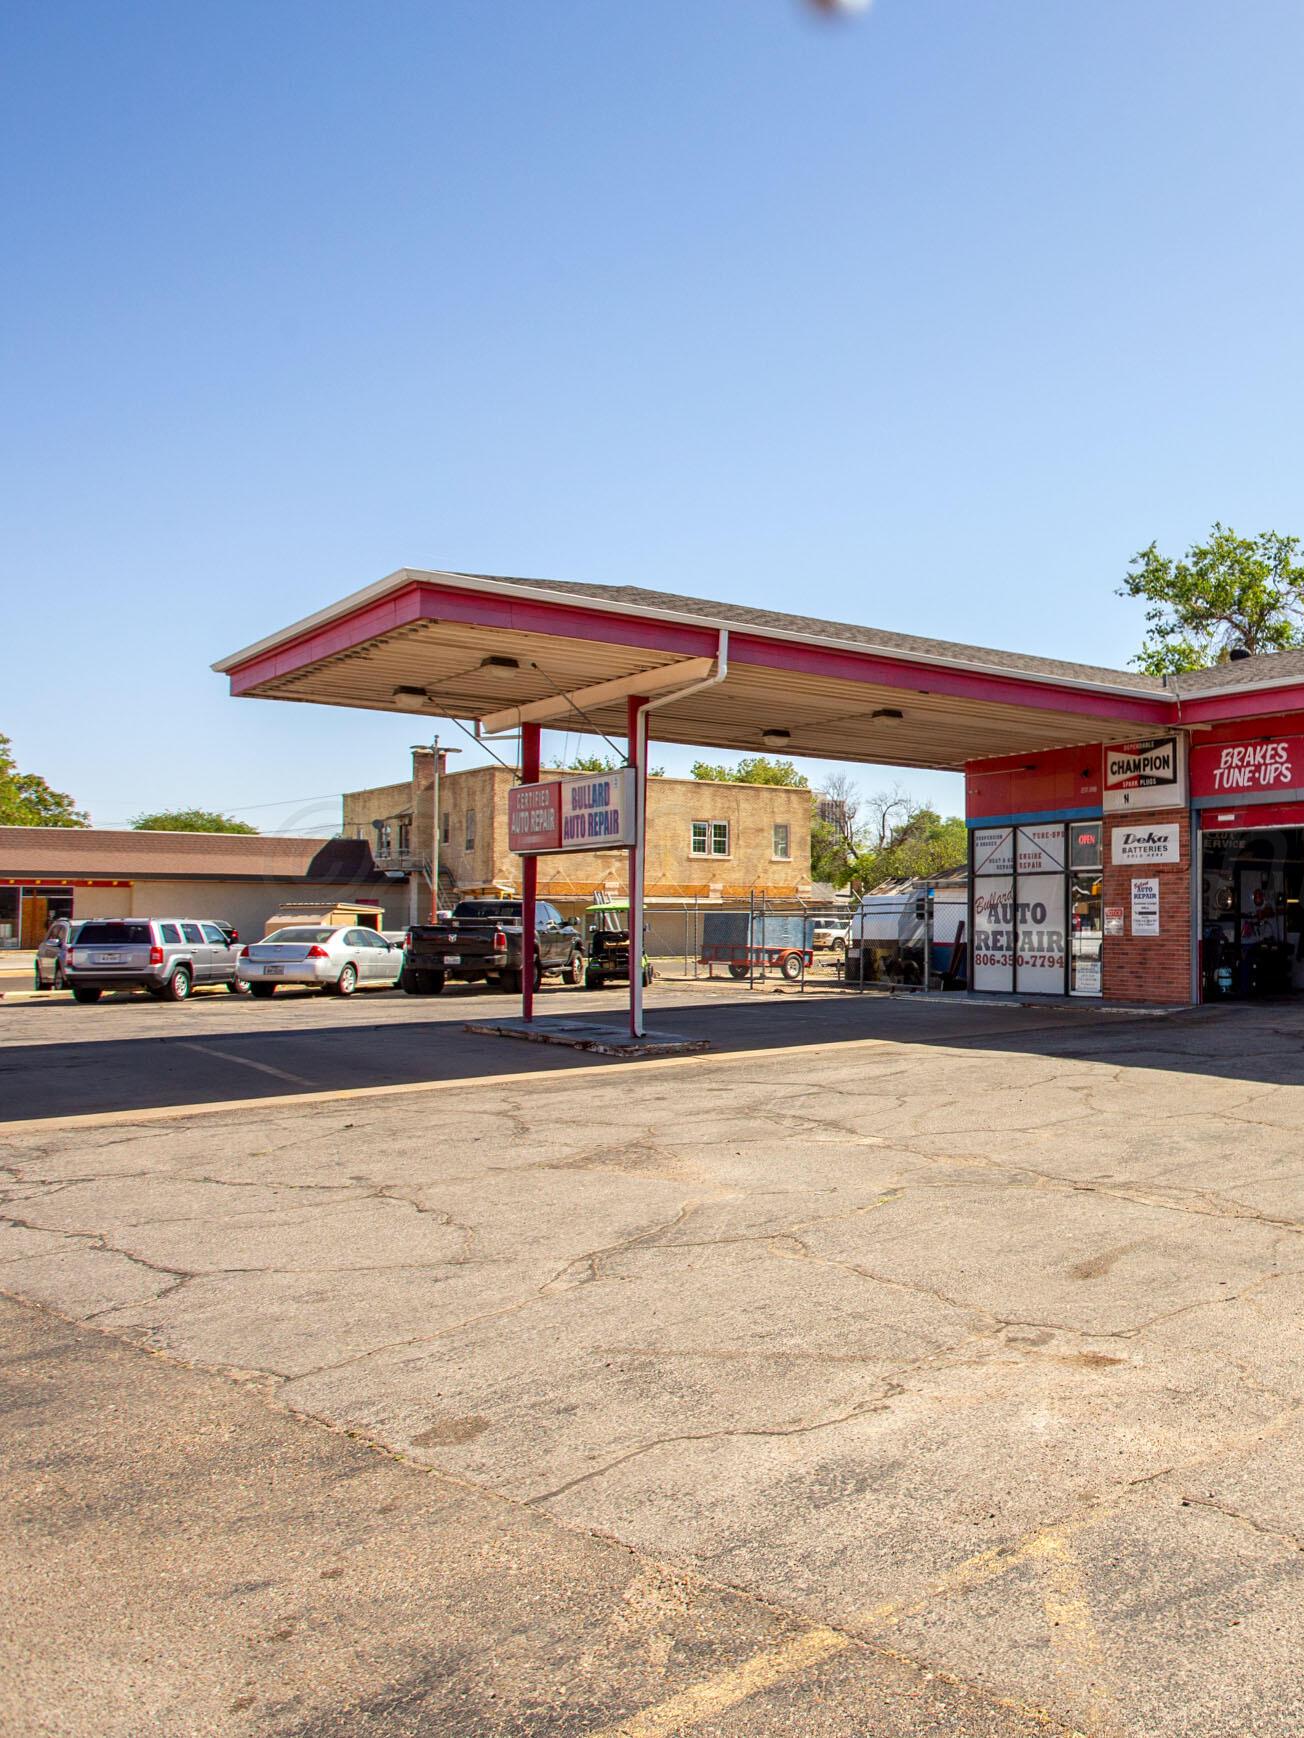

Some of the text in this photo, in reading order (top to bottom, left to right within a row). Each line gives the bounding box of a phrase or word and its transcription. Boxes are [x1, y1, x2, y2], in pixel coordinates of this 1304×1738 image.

[1110, 754, 1170, 775] CHAMPION
[1220, 742, 1289, 769] BRAKES
[1123, 778, 1157, 788] SPARK PLUGS
[517, 790, 549, 809] CERTIFIED
[571, 782, 610, 811] BULLARD
[511, 808, 556, 834] AUTO REPAIR
[563, 810, 619, 840] AUTO REPAIR
[1123, 832, 1169, 845] Deka
[1122, 845, 1168, 854] BATTERIES
[987, 902, 1047, 924] AUTO
[975, 930, 1064, 952] REPAIR
[975, 954, 1064, 968] 806-350-7794
